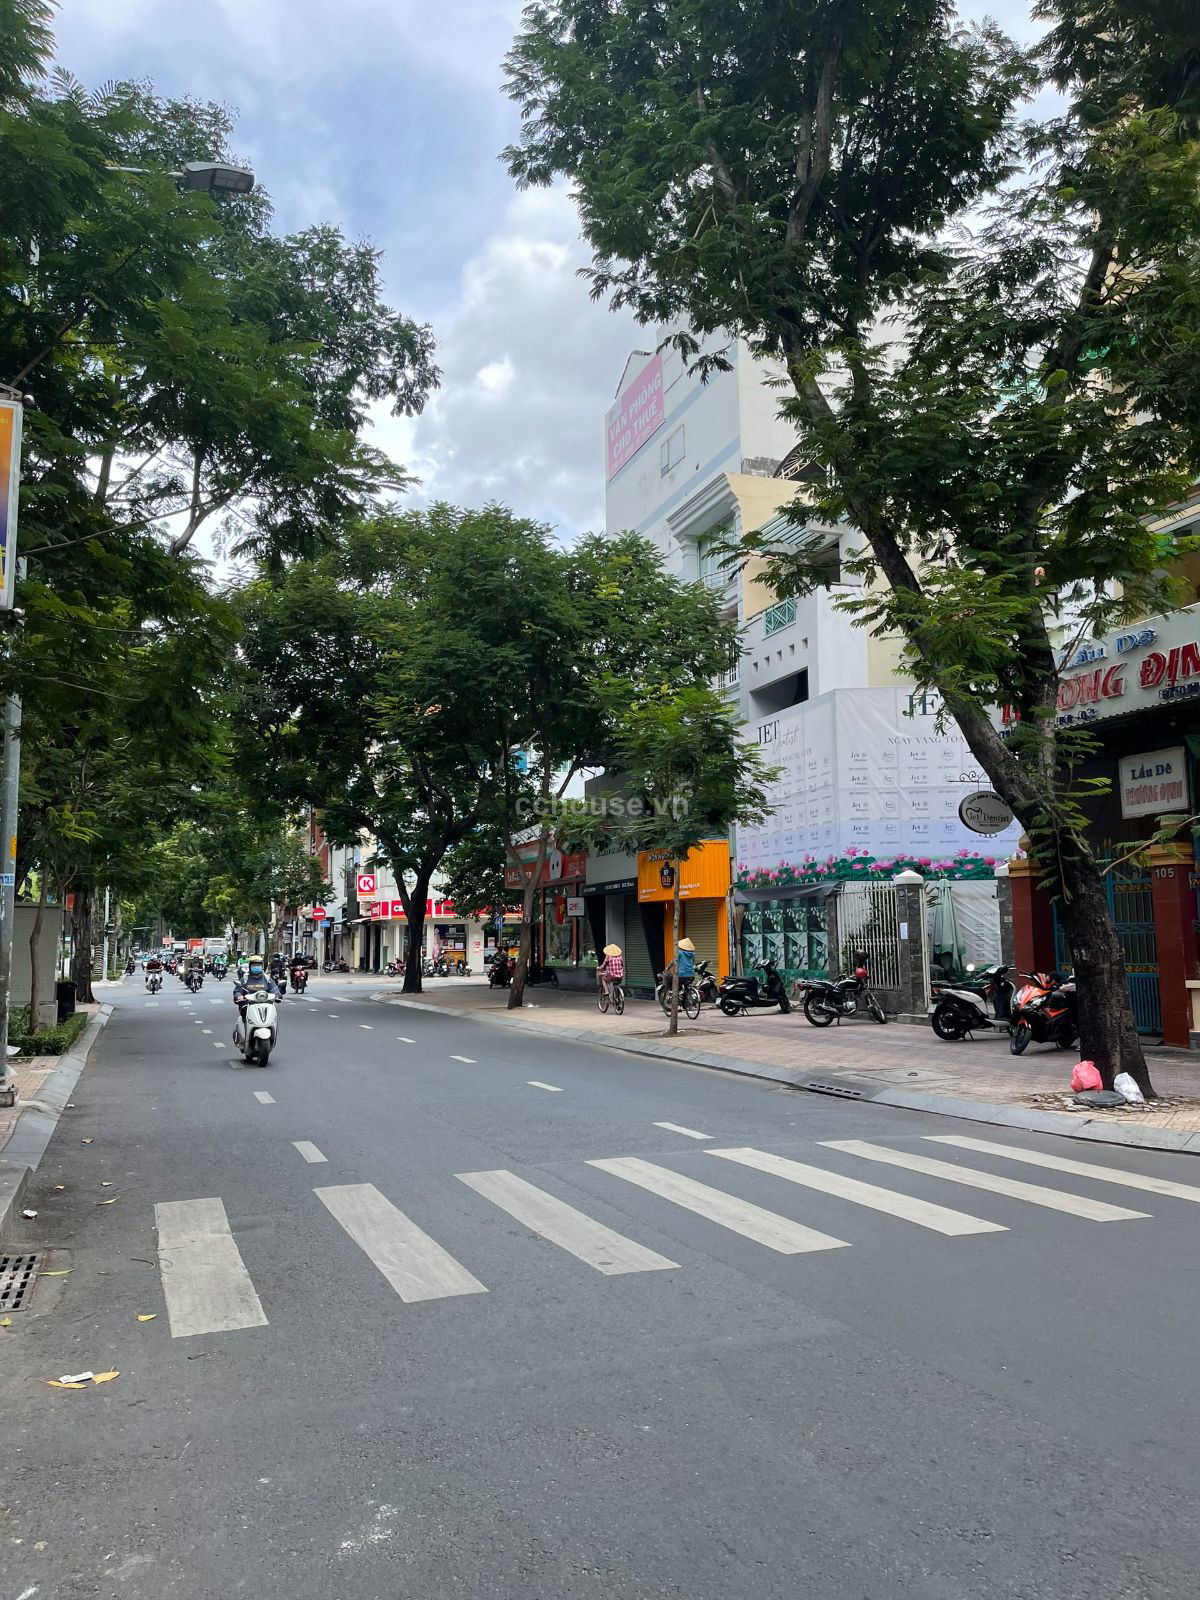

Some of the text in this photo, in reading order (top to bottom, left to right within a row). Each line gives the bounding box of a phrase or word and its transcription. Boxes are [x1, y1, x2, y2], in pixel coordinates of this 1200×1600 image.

[613, 430, 632, 460] CHO
[632, 395, 659, 437] THUÊ
[1115, 628, 1158, 655] Dê
[757, 719, 780, 747] JET
[1155, 763, 1172, 777] Dê
[1155, 867, 1174, 879] 105
